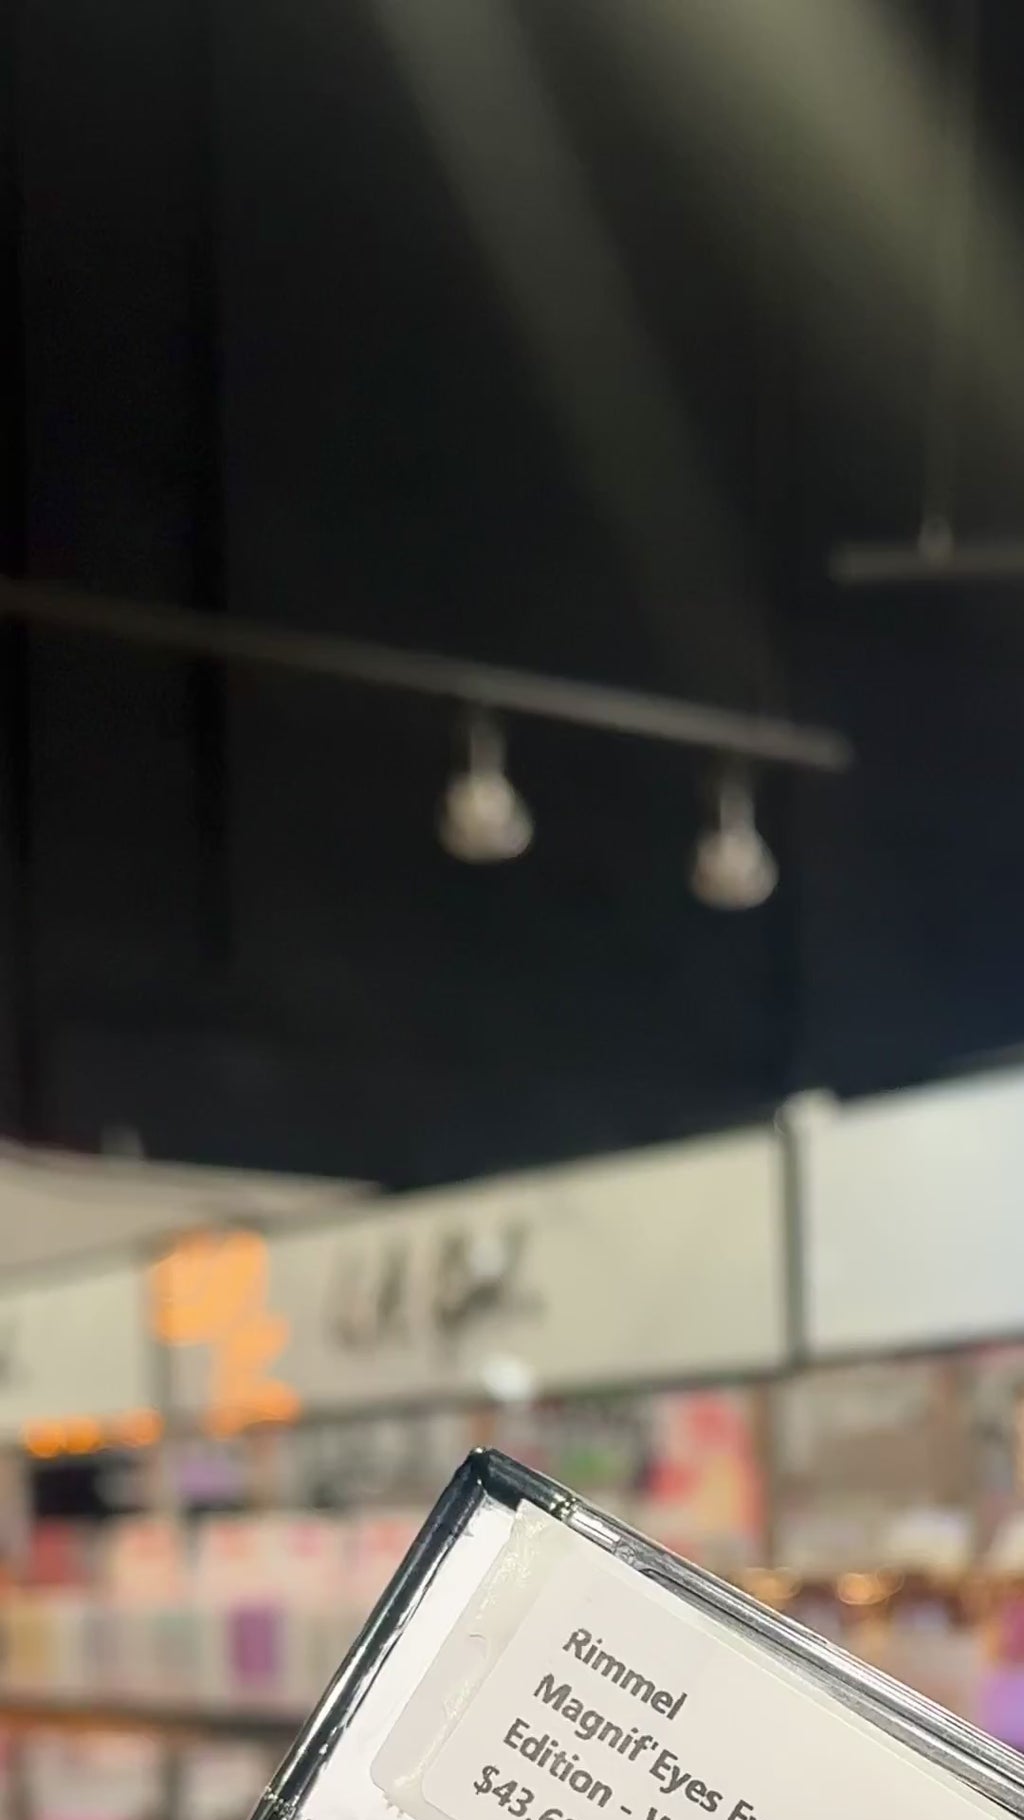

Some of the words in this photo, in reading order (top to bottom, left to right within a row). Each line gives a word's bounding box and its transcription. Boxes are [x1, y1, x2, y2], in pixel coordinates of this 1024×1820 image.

[562, 1628, 687, 1720] Rimmel
[503, 1718, 613, 1808] Edition
[533, 1674, 723, 1812] Magnif'Eyes
